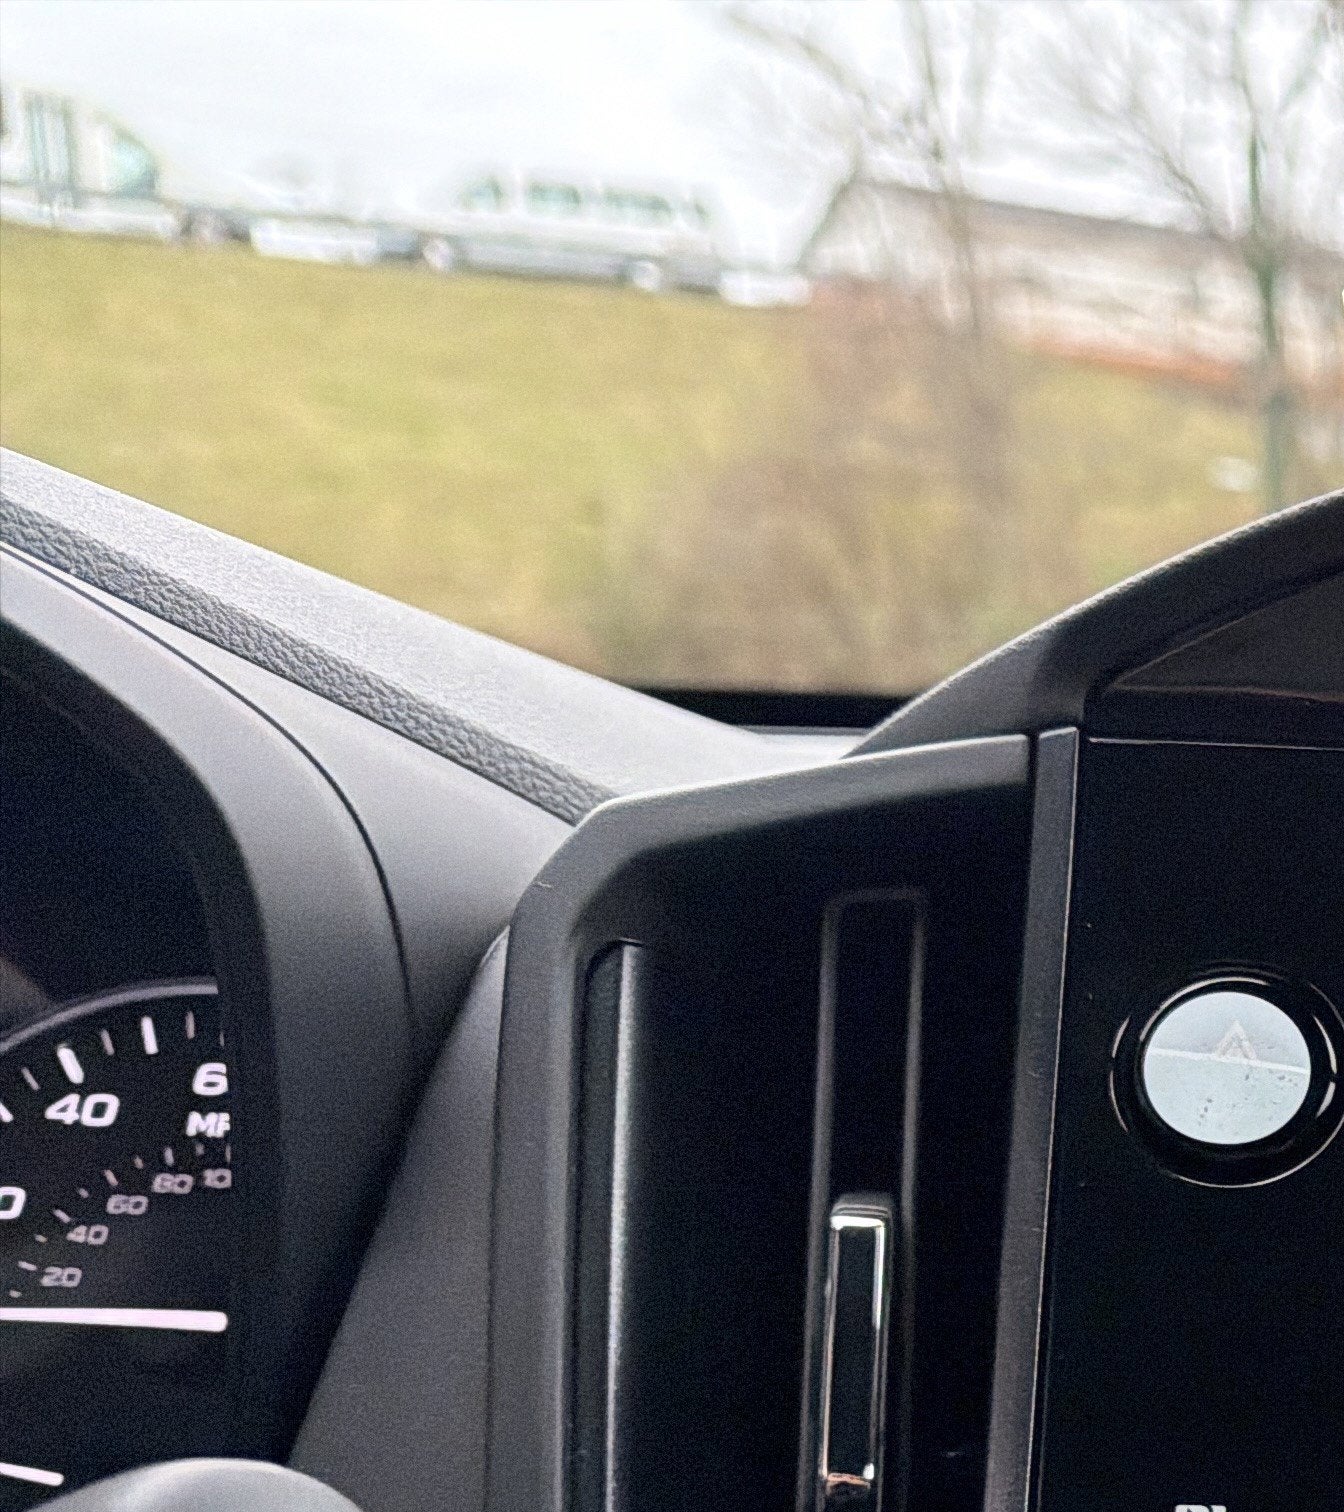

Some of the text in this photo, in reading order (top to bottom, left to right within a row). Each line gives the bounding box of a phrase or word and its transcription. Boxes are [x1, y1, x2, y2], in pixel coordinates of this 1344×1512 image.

[44, 1093, 120, 1127] 40
[66, 1225, 109, 1245] 40
[40, 1266, 82, 1287] 20
